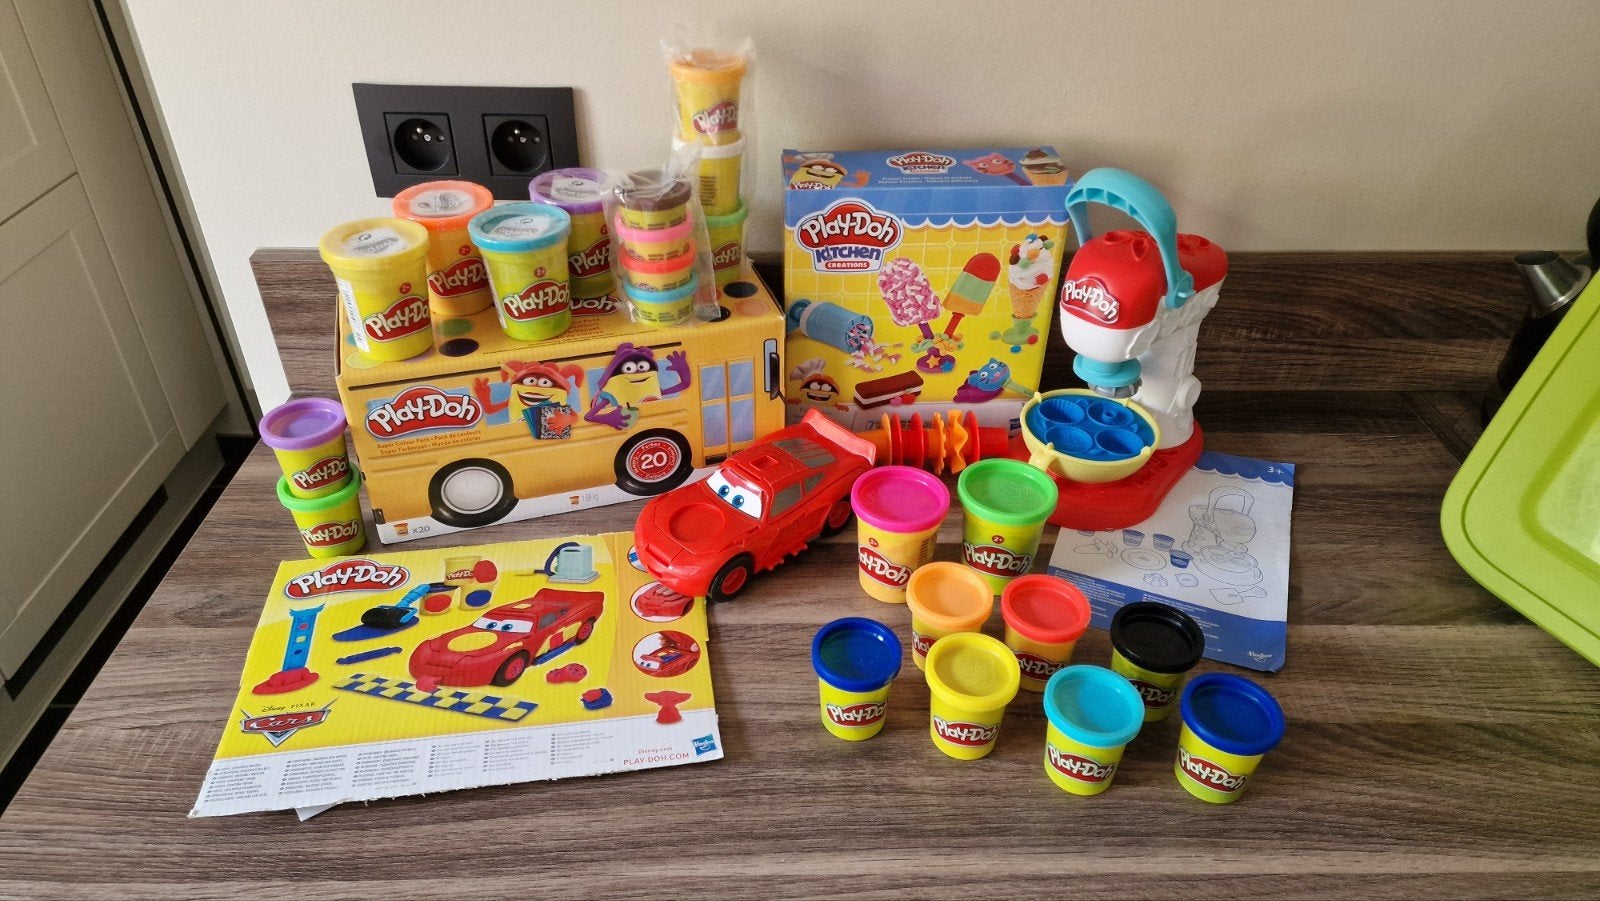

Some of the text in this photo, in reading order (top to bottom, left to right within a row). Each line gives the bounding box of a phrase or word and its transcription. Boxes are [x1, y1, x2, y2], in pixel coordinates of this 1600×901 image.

[891, 155, 950, 165] Play-Doh
[801, 211, 894, 244] Play-Doh
[1063, 281, 1118, 319] Play-Doh
[364, 301, 430, 337] Play-Do
[368, 394, 476, 432] Play-Doh
[293, 459, 348, 488] Play-Do
[641, 451, 668, 470] 20
[1267, 466, 1284, 475] 3+
[301, 520, 359, 544] Play-Doh
[412, 526, 430, 534] x20
[859, 552, 908, 584] ay-Doh
[964, 541, 1030, 573] Play-Doh
[293, 564, 402, 595] Play-Doh
[250, 715, 313, 729] Cars
[934, 717, 999, 742] Play-Doh
[623, 752, 690, 766] PLAY-DOH.COM
[1048, 744, 1113, 778] Play-Doh
[1180, 748, 1246, 790] Play-Doh
